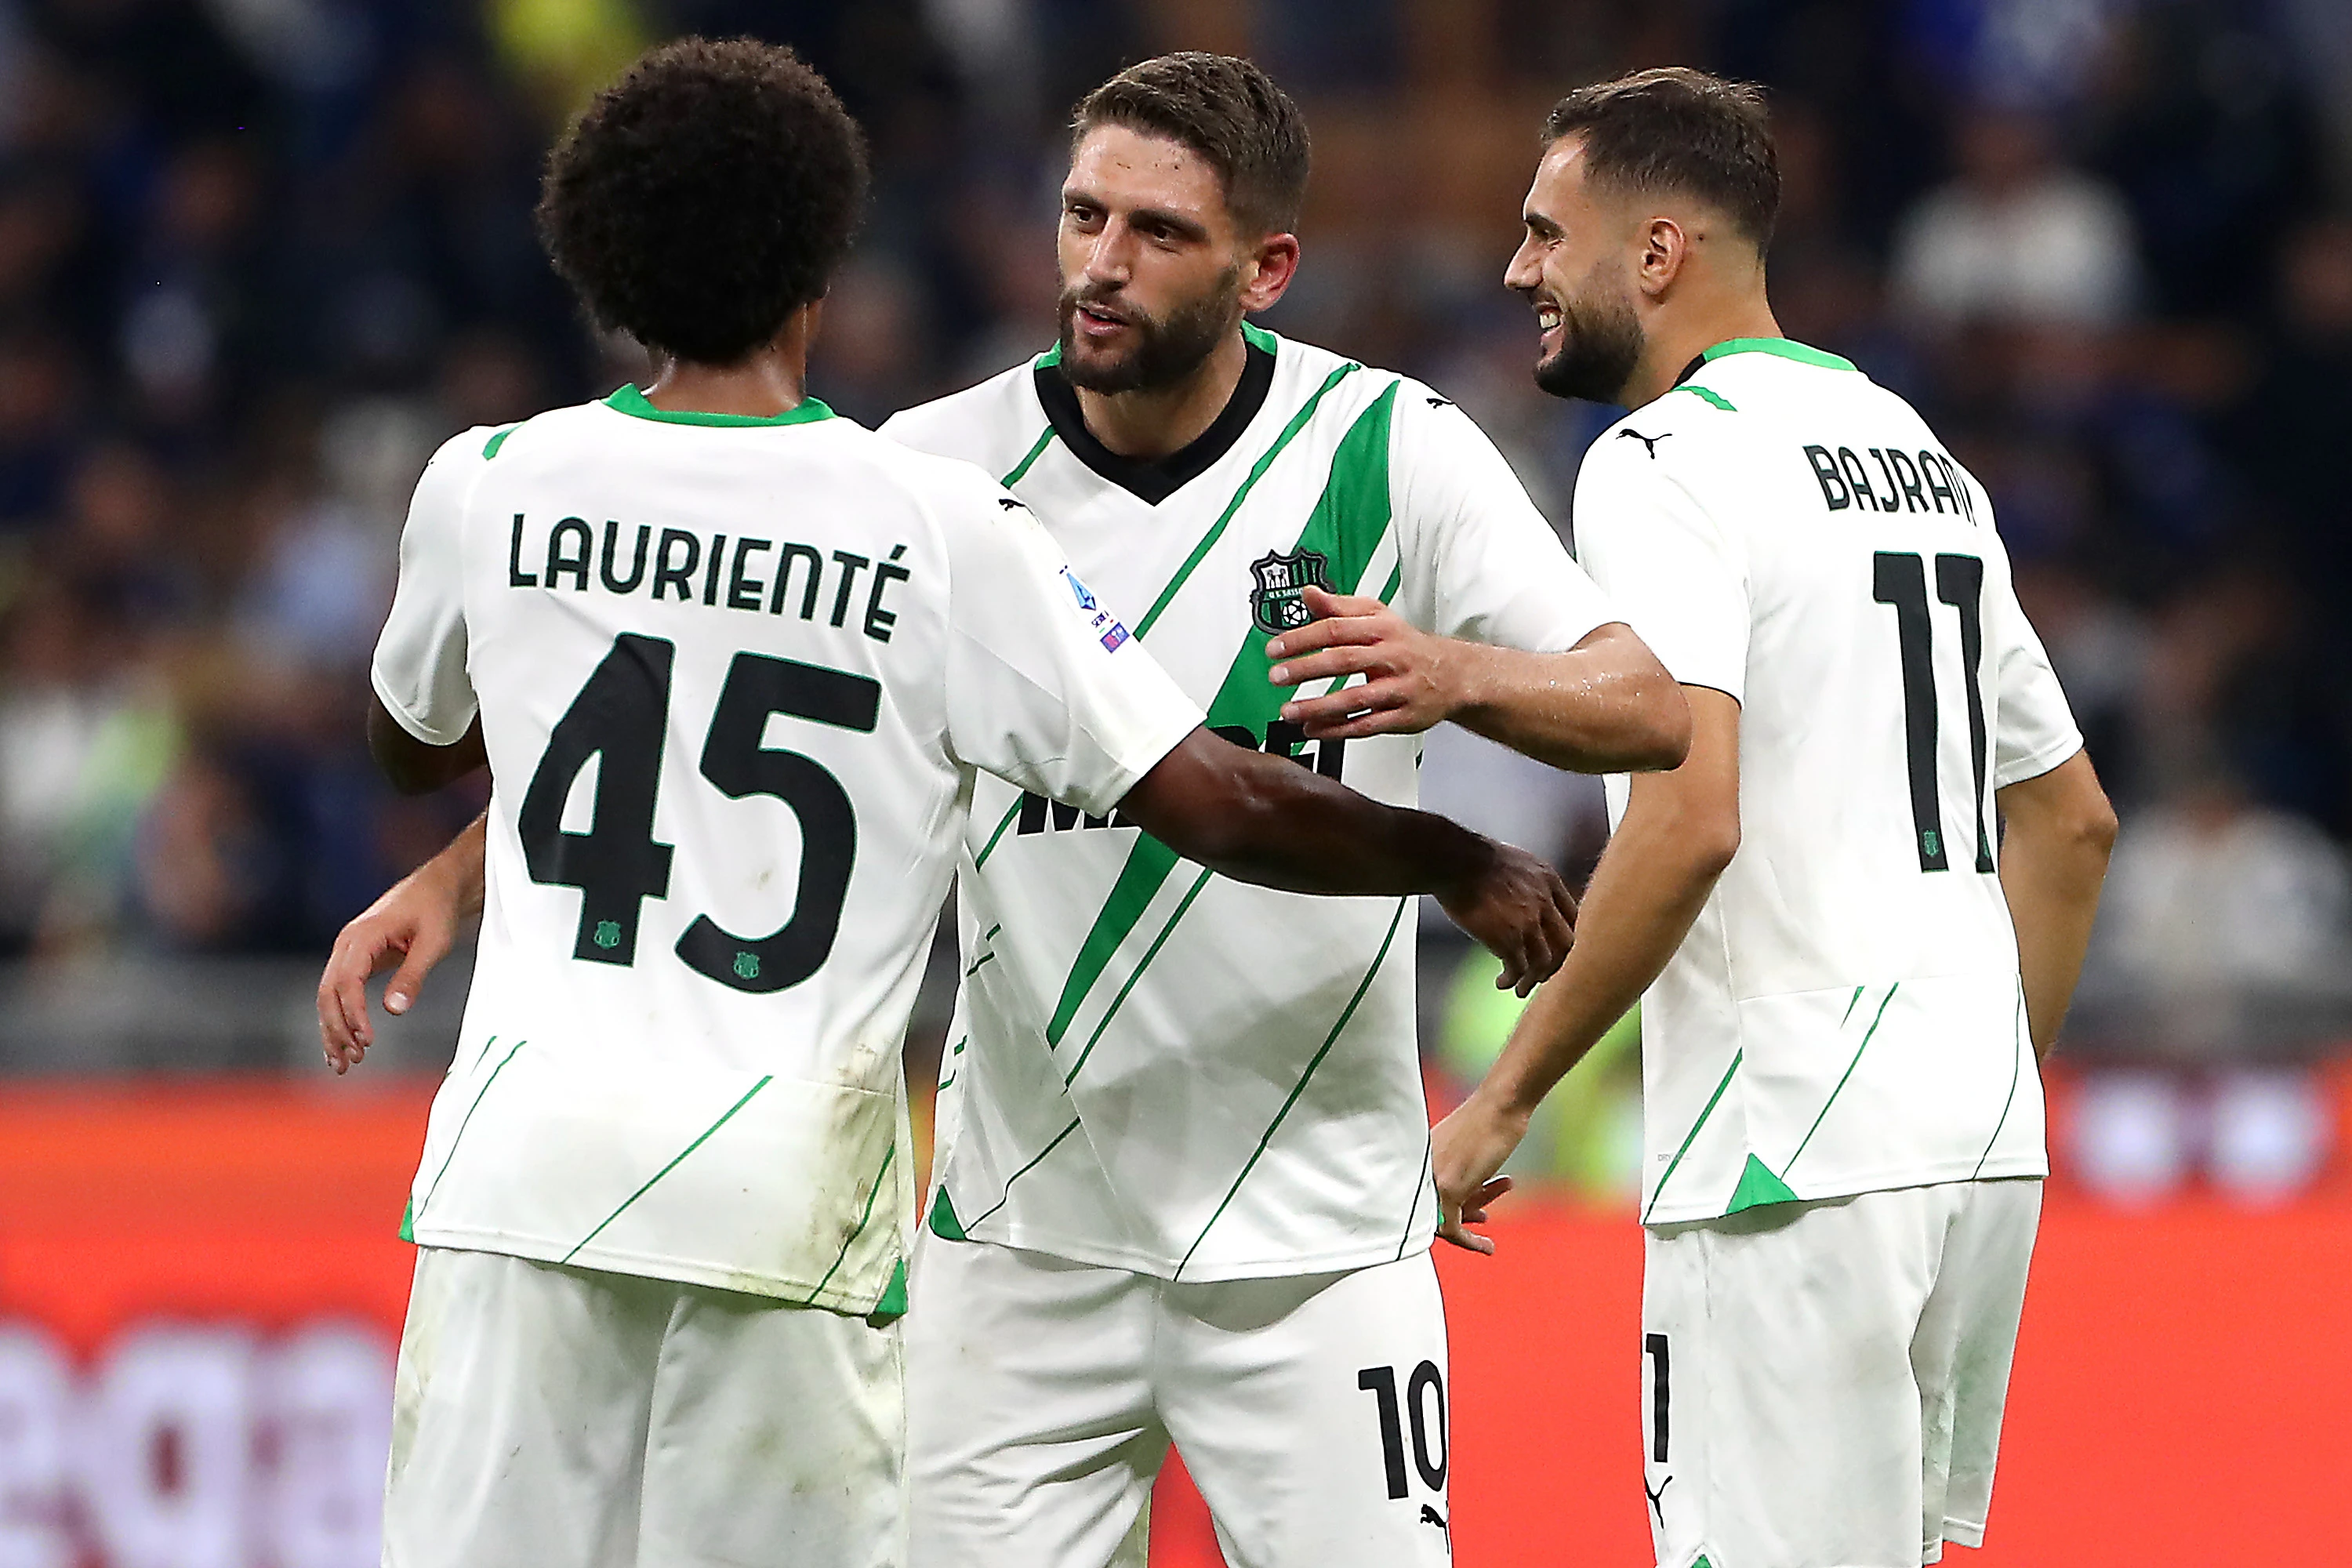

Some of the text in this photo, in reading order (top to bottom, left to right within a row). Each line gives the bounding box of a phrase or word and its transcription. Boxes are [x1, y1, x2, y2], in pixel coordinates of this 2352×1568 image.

[510, 514, 910, 644] LAURIENTÉ
[517, 632, 882, 994] 45
[1873, 550, 1996, 873] 11
[1358, 1360, 1448, 1501] 10
